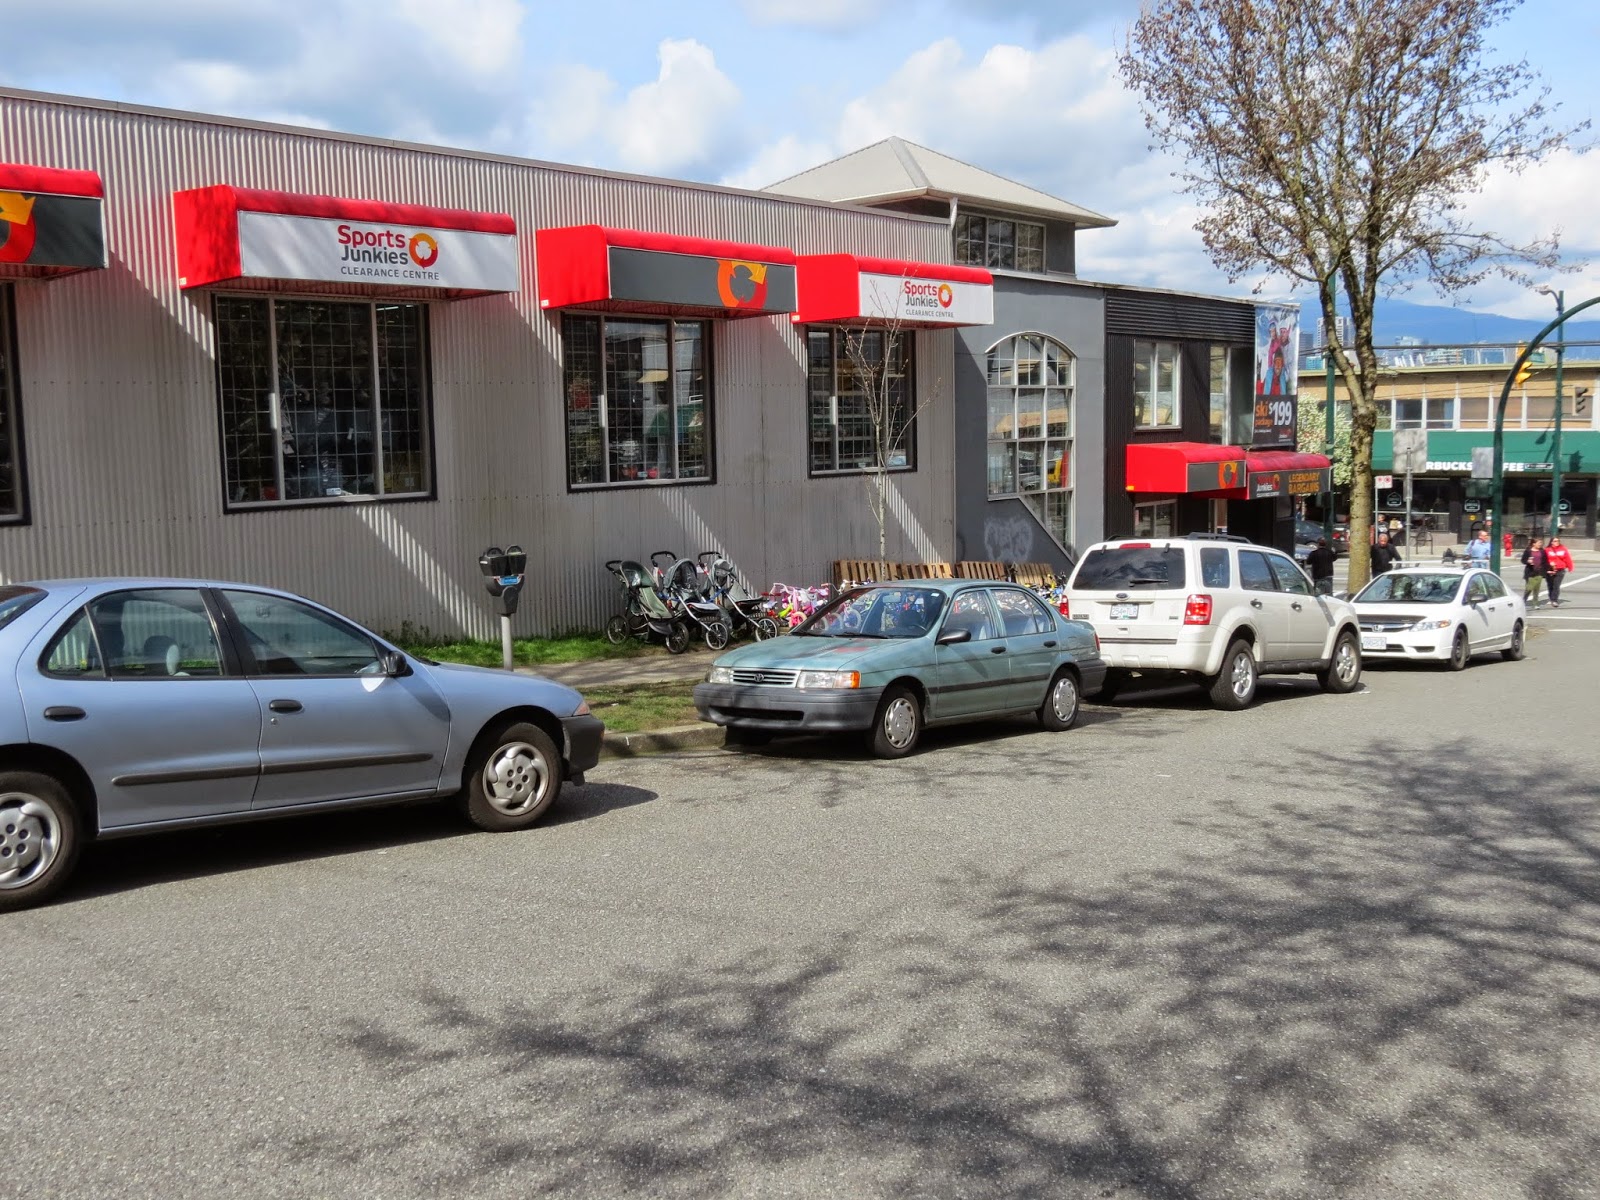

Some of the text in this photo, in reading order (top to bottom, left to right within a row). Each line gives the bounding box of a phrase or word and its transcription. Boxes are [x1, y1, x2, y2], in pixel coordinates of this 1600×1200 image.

[337, 224, 406, 248] Sports
[341, 245, 408, 265] Junkies
[341, 266, 439, 280] CLEARANCE CENTRE
[904, 280, 938, 296] Sports
[905, 295, 938, 308] Junkies
[906, 309, 934, 317] CLEARANCE
[1425, 461, 1473, 471] RBUCKS
[1502, 462, 1524, 472] FEE
